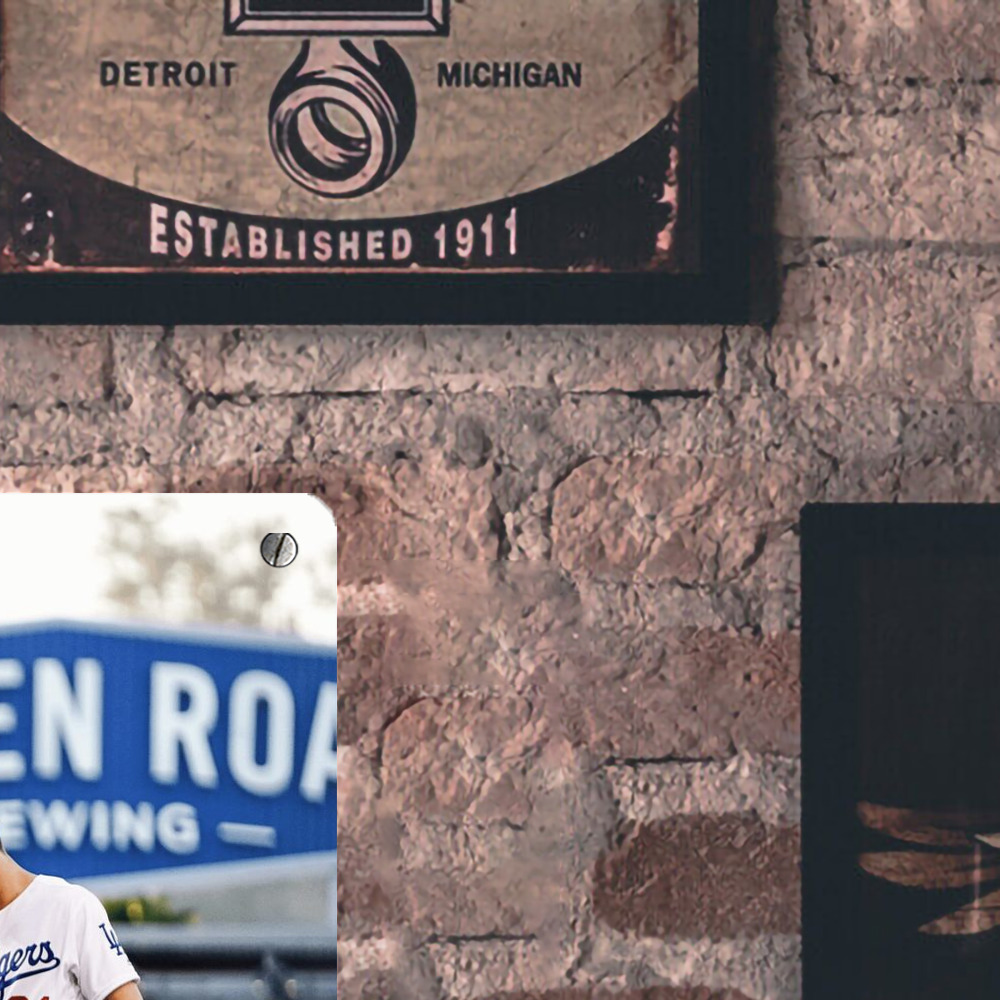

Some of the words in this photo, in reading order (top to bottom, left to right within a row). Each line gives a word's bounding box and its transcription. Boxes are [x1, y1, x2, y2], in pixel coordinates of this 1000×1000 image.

[100, 61, 237, 87] DETROIT
[437, 62, 581, 88] MICHIGAN
[149, 203, 412, 260] ESTABLISHED
[435, 208, 518, 259] 1911
